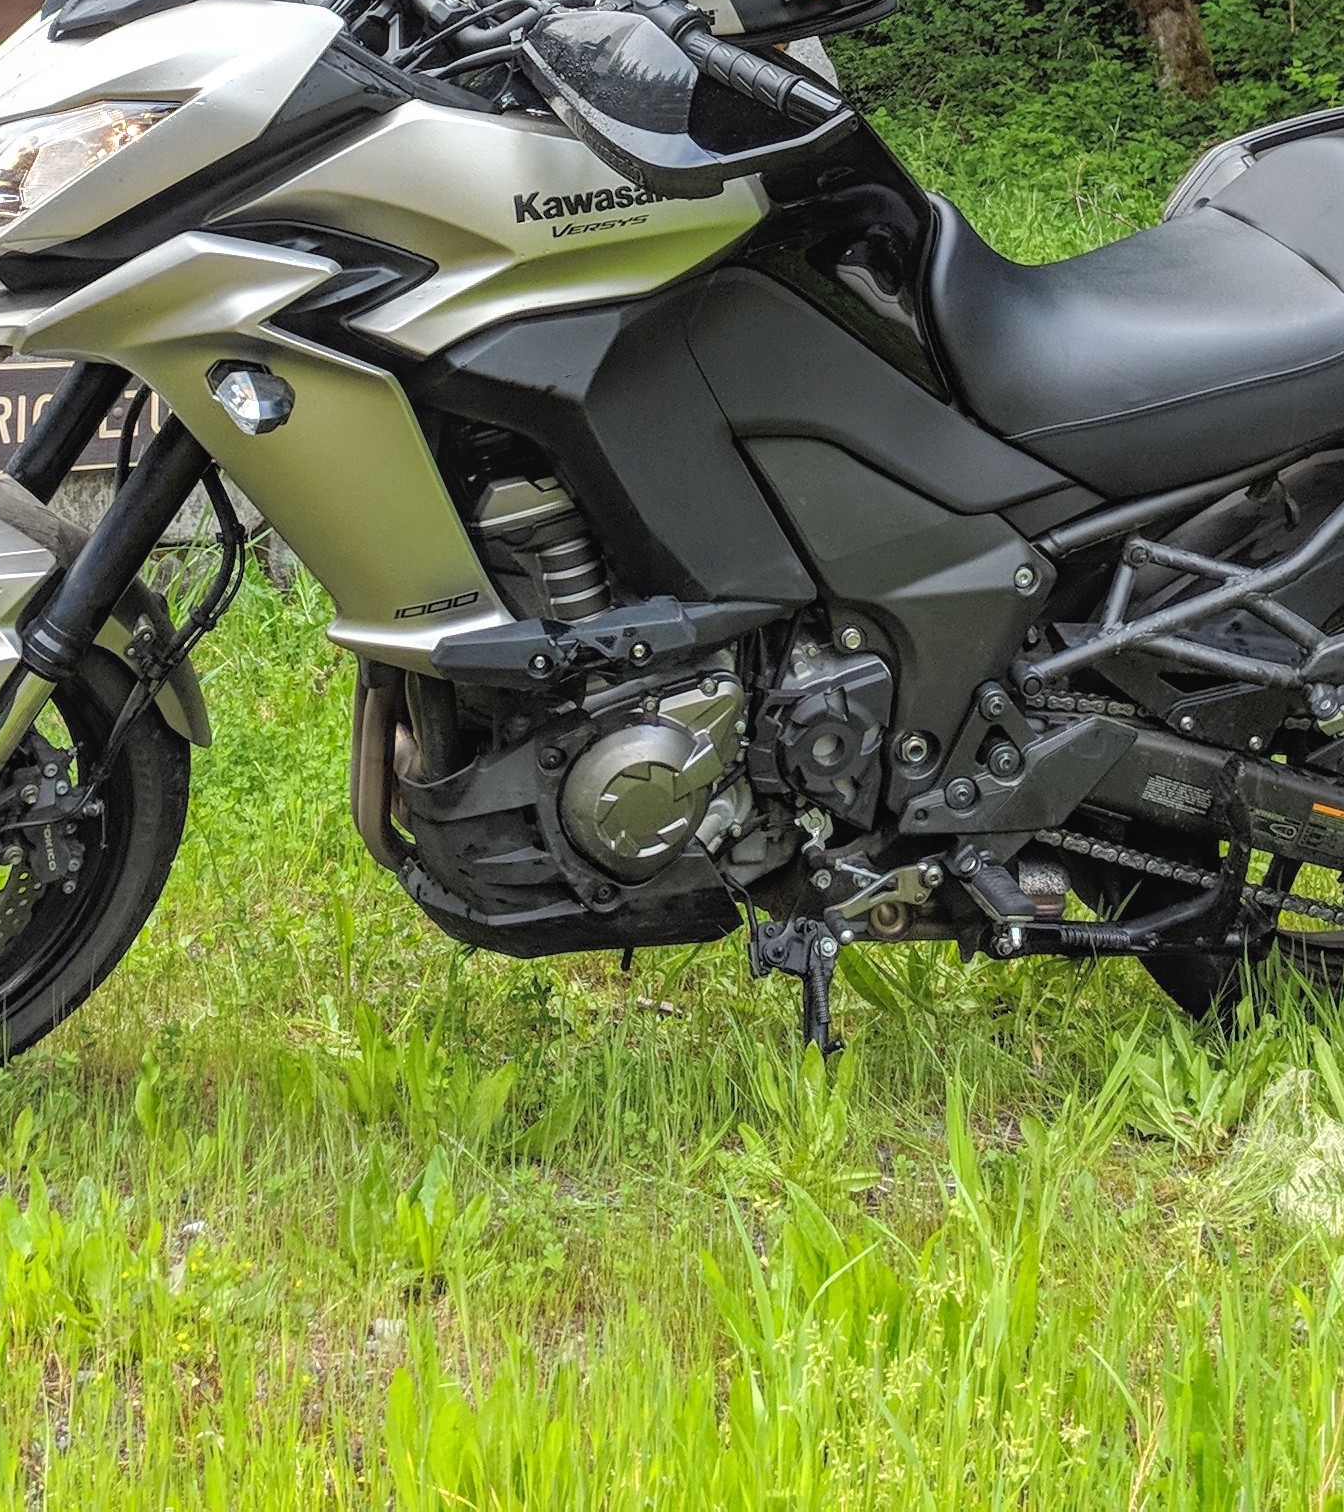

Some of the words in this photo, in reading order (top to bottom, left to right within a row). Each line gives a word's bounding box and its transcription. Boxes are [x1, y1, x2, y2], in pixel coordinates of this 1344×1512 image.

[513, 185, 674, 224] Kawasa
[552, 214, 650, 239] VERSYS
[394, 591, 480, 620] 1000
